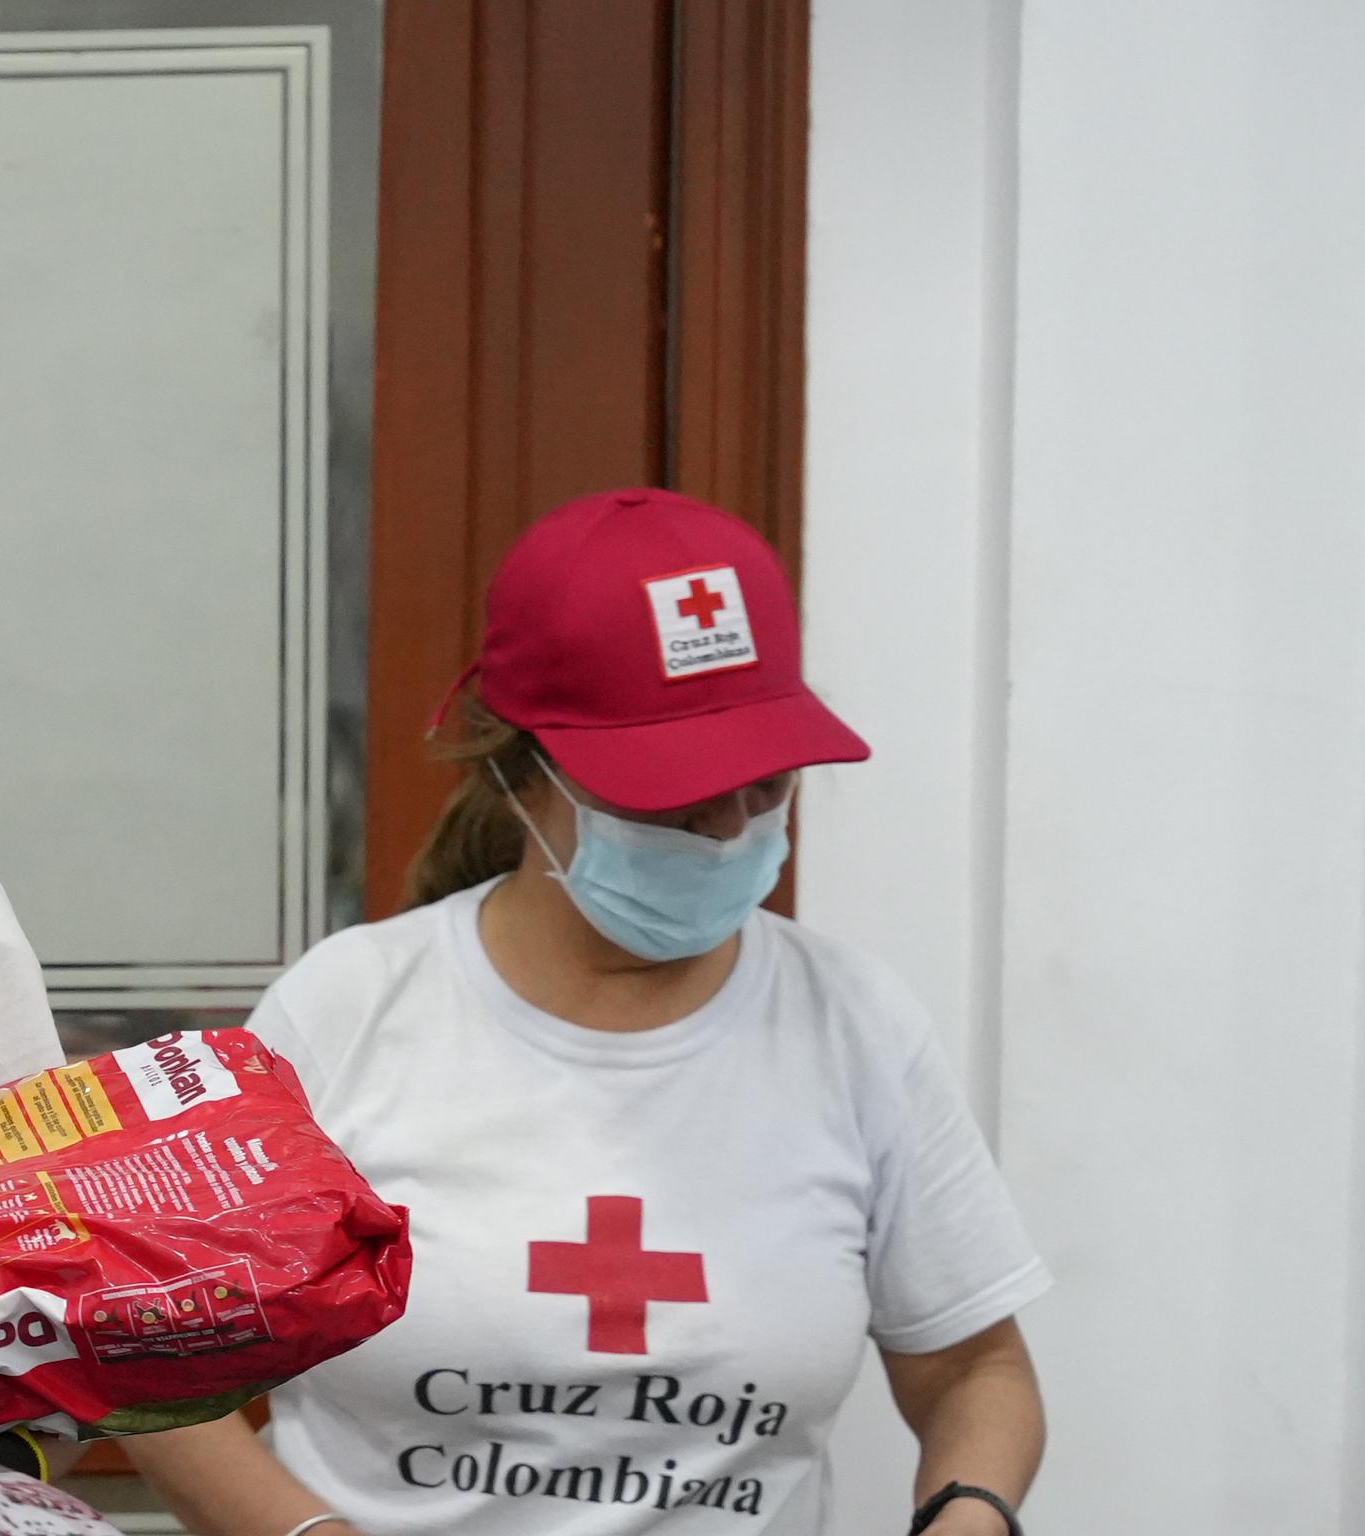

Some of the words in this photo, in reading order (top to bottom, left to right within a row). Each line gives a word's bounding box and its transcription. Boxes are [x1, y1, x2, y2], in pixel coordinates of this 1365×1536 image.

[670, 634, 712, 653] Cruz
[413, 1368, 598, 1418] Cruz
[624, 1374, 788, 1446] Roja
